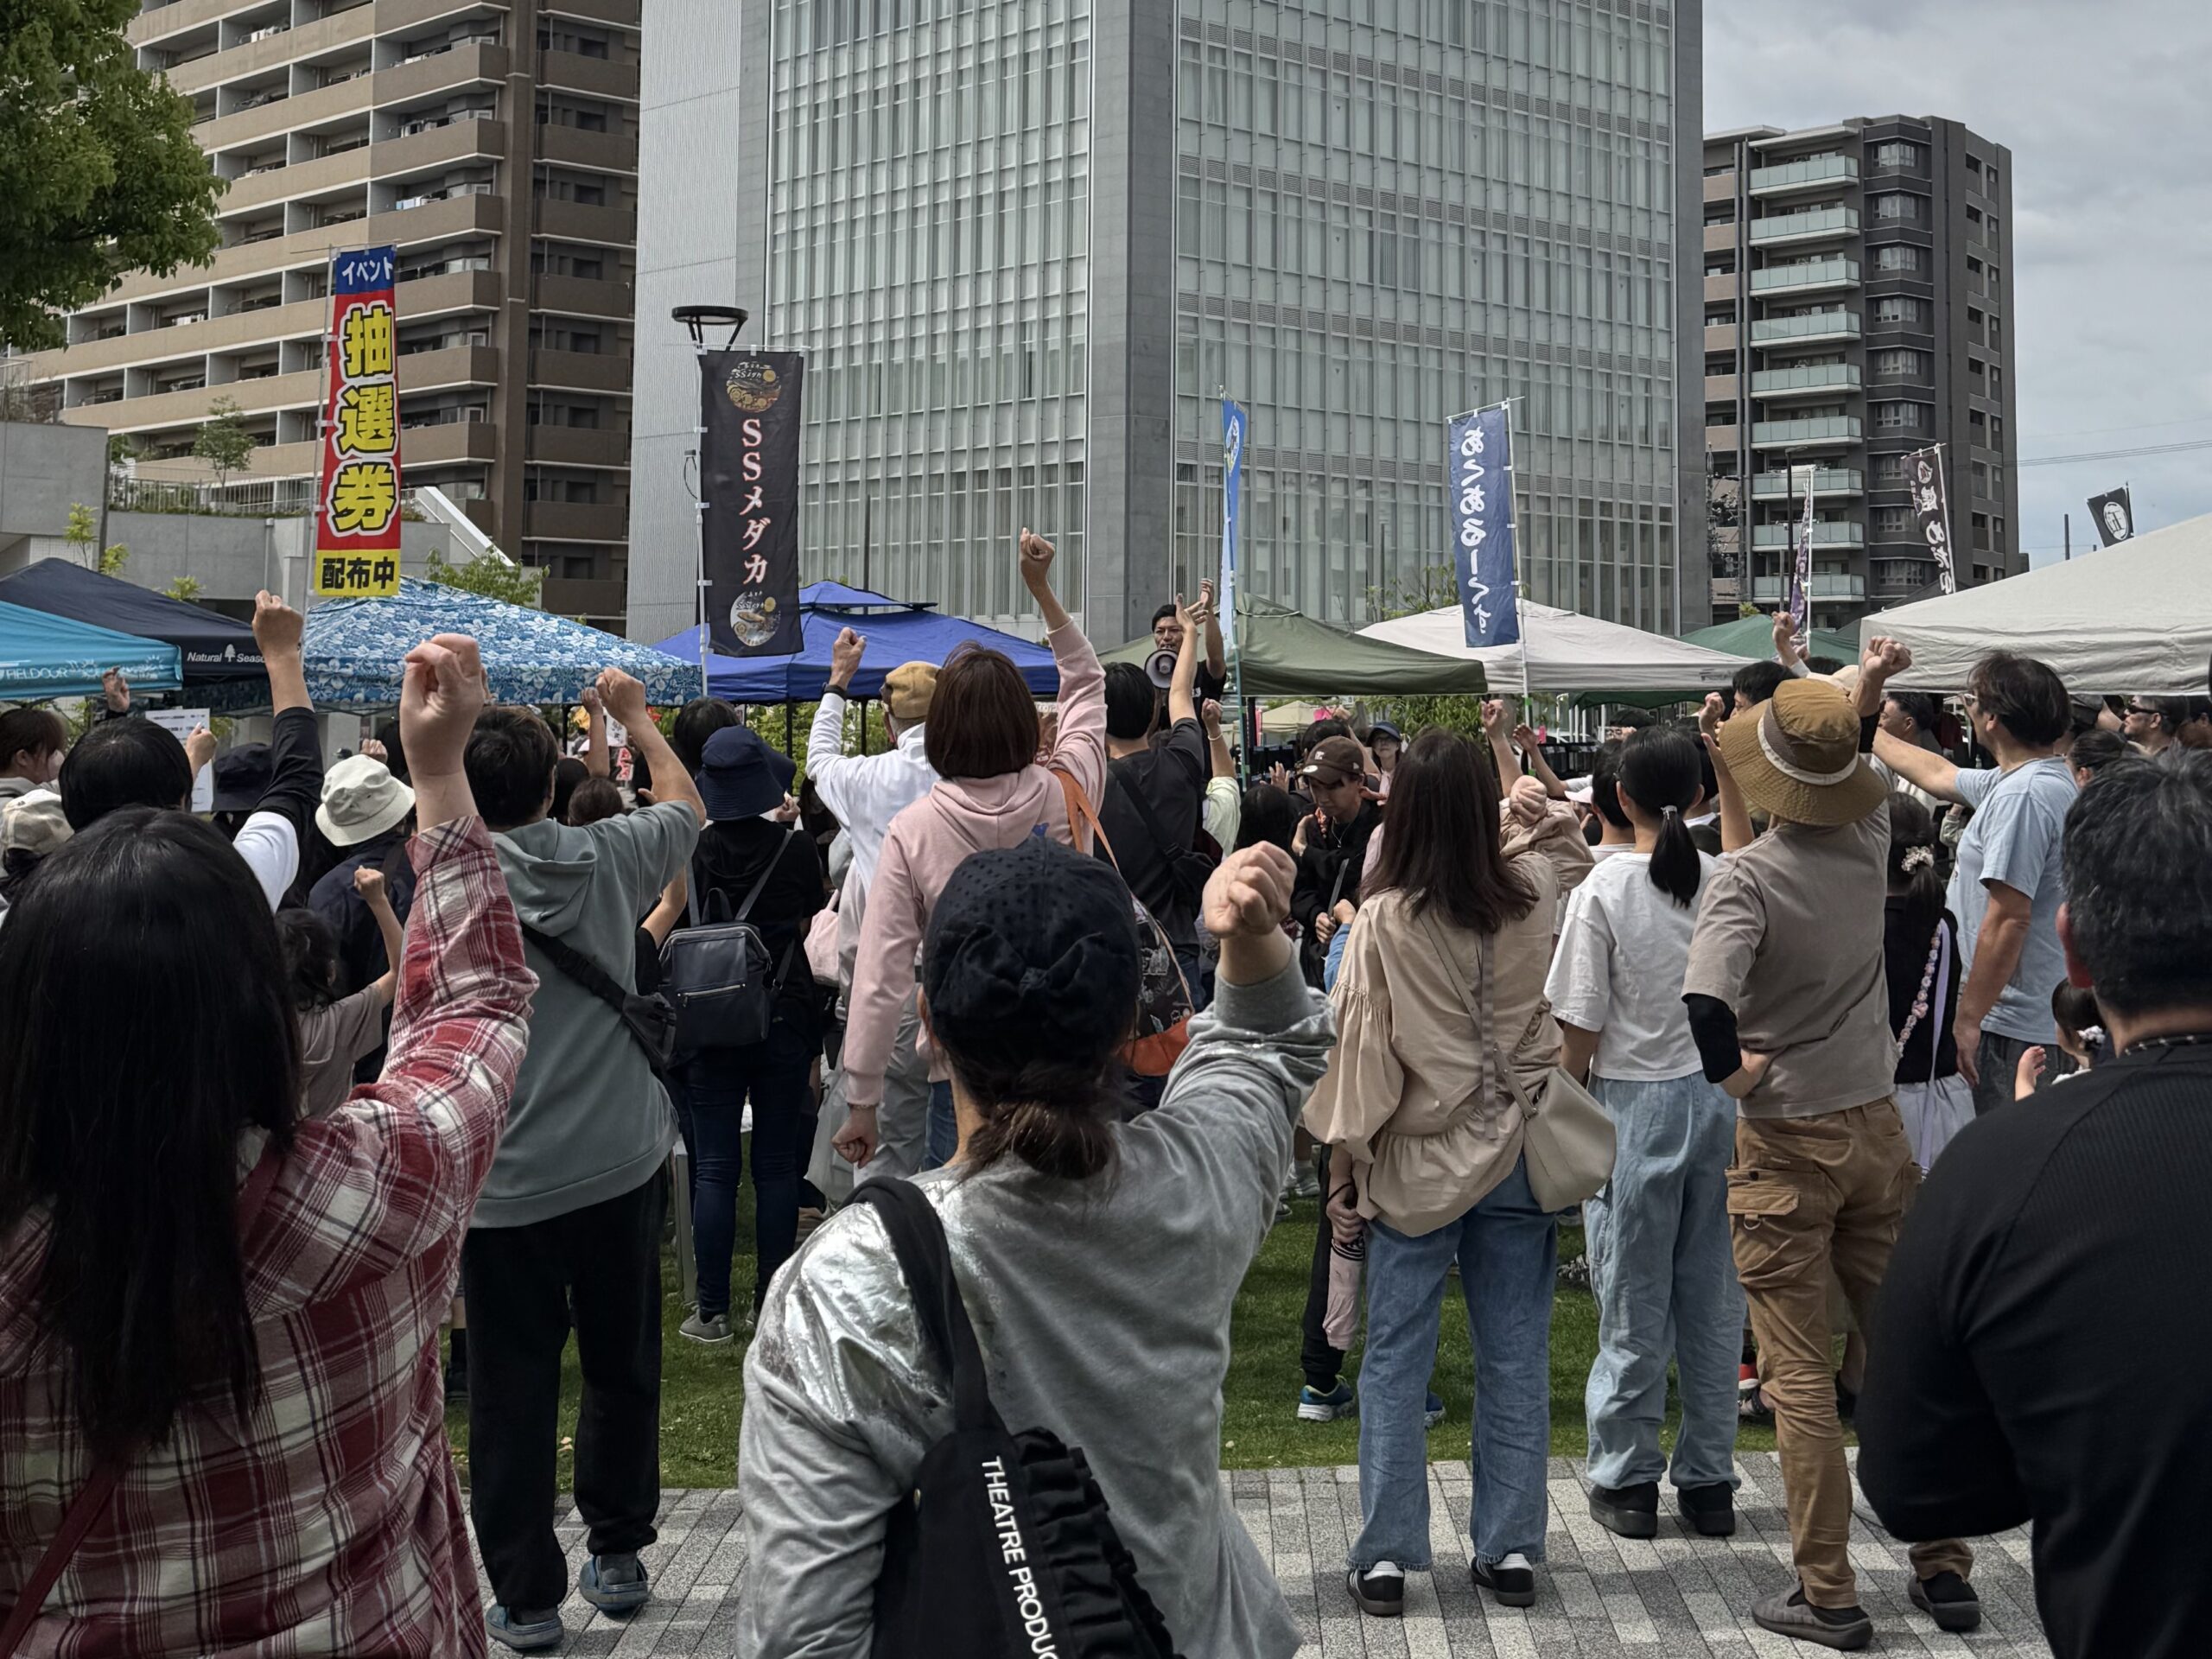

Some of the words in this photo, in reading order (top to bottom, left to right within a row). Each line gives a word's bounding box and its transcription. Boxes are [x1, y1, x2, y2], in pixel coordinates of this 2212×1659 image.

[342, 255, 394, 286] イベント
[332, 302, 397, 534] 抽選券
[740, 418, 771, 585] SSメダカ
[321, 556, 396, 590] 配布中
[187, 651, 223, 663] Natural
[982, 1456, 1027, 1565] THEATRE
